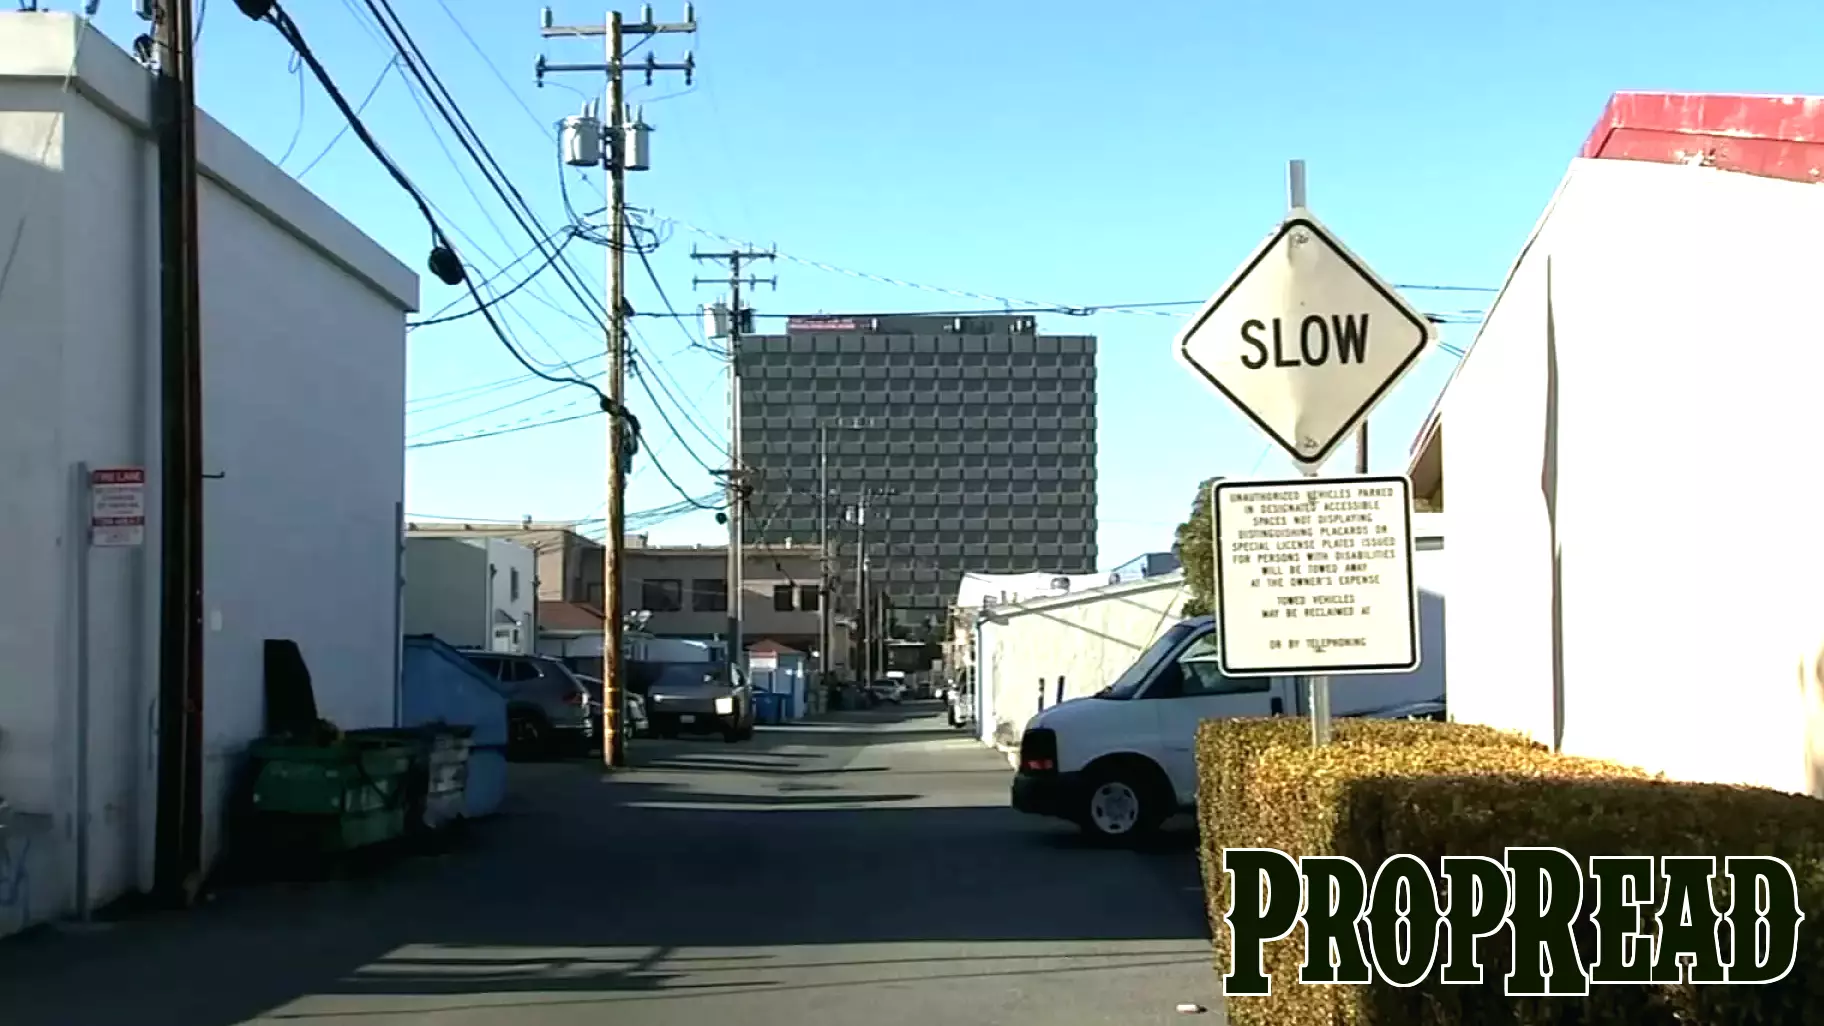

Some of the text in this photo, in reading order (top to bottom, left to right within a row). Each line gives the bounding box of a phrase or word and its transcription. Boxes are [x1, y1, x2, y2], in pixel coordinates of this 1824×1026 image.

[1240, 313, 1369, 370] SLOW
[1230, 488, 1393, 502] UNAUTHORIZED VEHICLES PARKED
[1260, 503, 1317, 513] DESIGNATED
[1324, 501, 1380, 511] ACCESSIBLE
[1253, 513, 1373, 526] SPACES NOT DISPLAYING
[1319, 527, 1369, 536] PLACARDS
[1232, 537, 1396, 552] SPECIAL LICENSE PLATES ISSUED
[1232, 550, 1395, 564] FOR PERSONS WITH DISABILITIES
[1262, 563, 1368, 575] WILL BE TOWED AWAY
[1251, 575, 1380, 588] AT THE OWNER'S EXPENSE
[1277, 595, 1355, 605] TOWED VEHICLES
[1262, 606, 1371, 618] MAY BE RECLAIMED AT
[1288, 639, 1300, 649] BY
[1306, 638, 1367, 648] TELEPHONING
